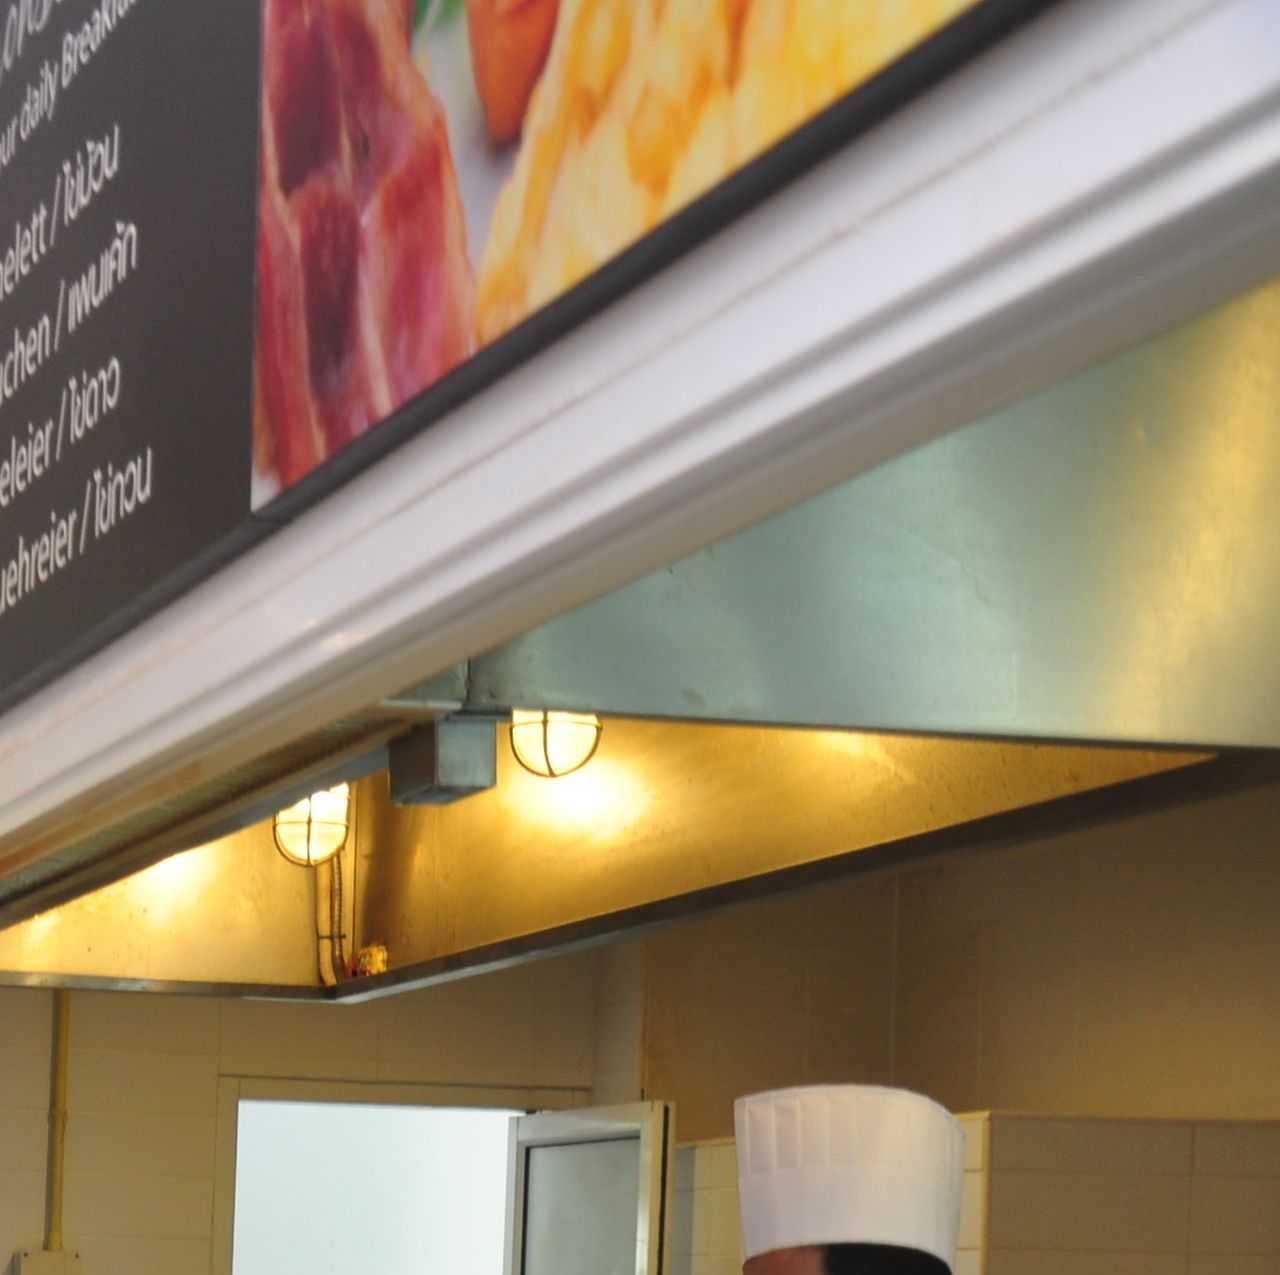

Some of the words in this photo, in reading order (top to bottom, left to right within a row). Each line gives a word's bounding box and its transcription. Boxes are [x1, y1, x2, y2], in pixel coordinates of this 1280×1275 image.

[20, 59, 59, 142] daily
[50, 174, 61, 247] /
[54, 278, 65, 352] /
[56, 389, 67, 462] /
[80, 480, 92, 555] /
